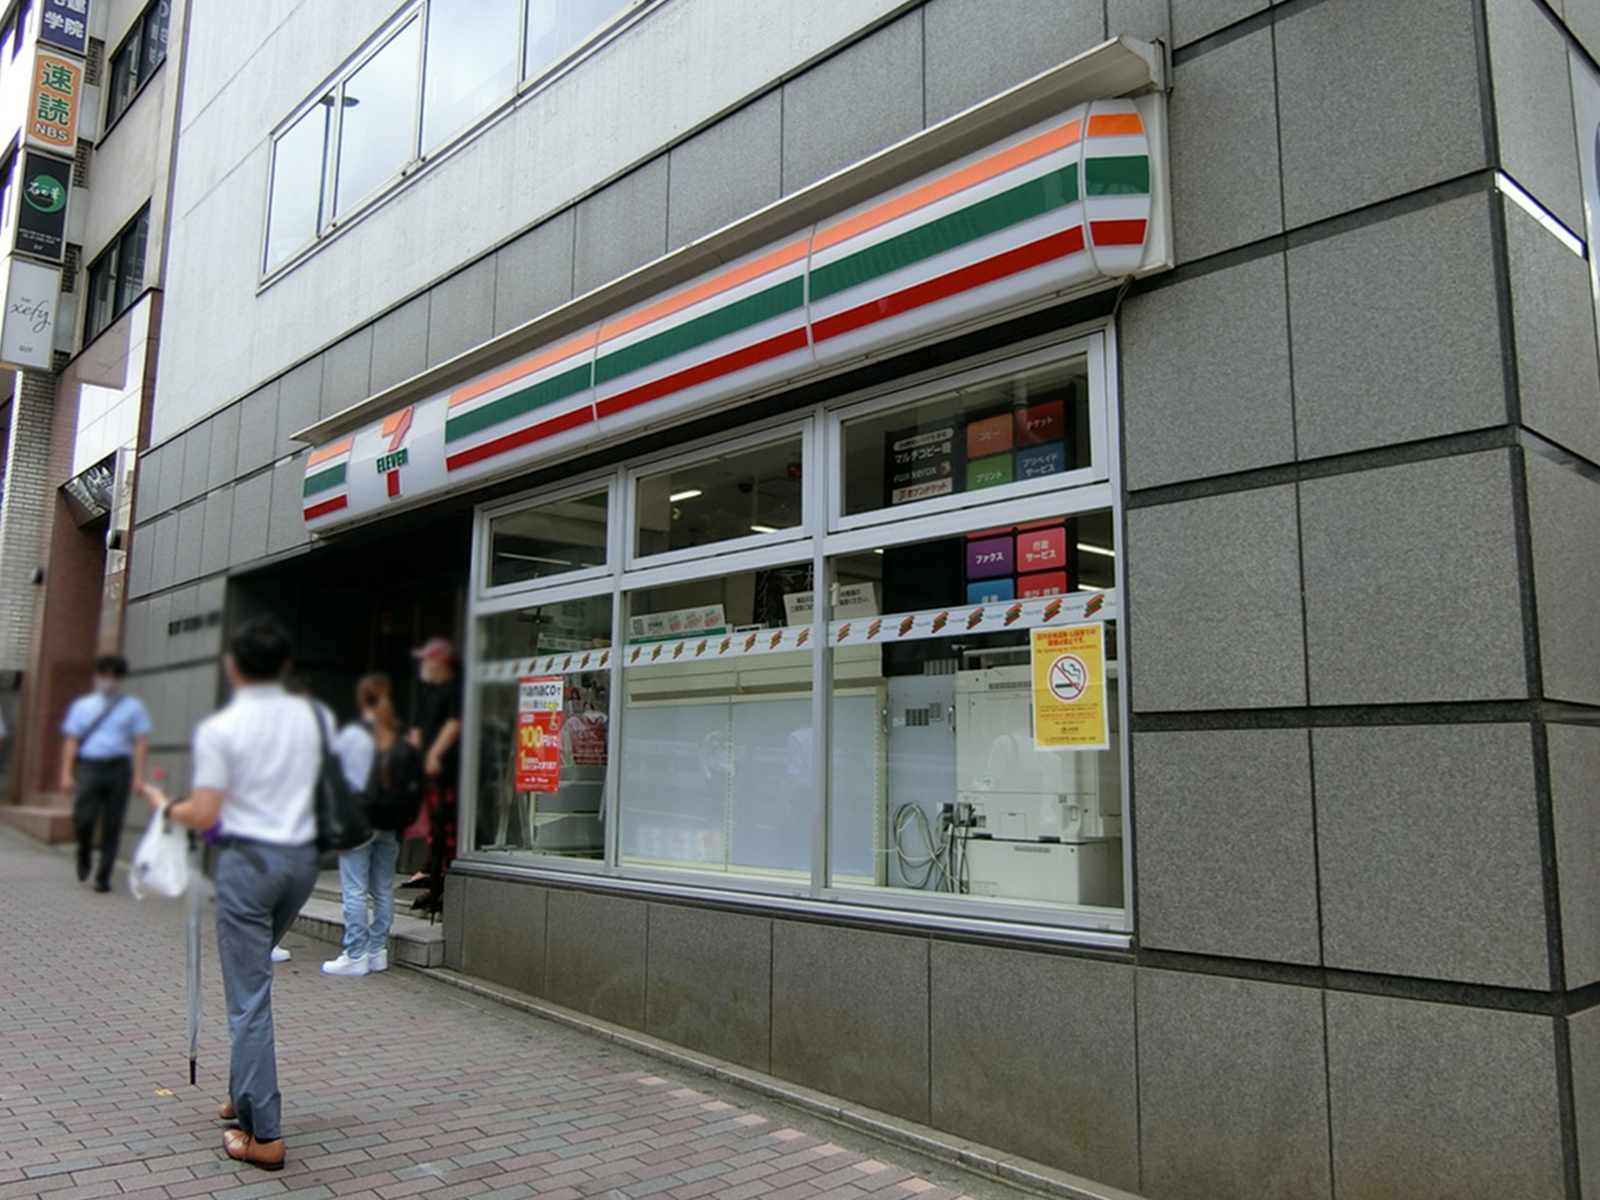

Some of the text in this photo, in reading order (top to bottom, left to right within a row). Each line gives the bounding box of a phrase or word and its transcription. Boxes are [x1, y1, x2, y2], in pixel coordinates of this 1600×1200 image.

[44, 11, 84, 39] 学院
[37, 61, 74, 126] 速読
[35, 122, 68, 142] NBS
[1026, 416, 1053, 431] チケット
[978, 430, 1000, 441] コピー
[894, 441, 952, 464] マルチコピー機
[1022, 453, 1058, 468] プリペイド
[976, 470, 1004, 484] プリント
[1025, 463, 1056, 477] サービス
[975, 551, 1004, 564] ファクス
[1025, 549, 1056, 562] サービス
